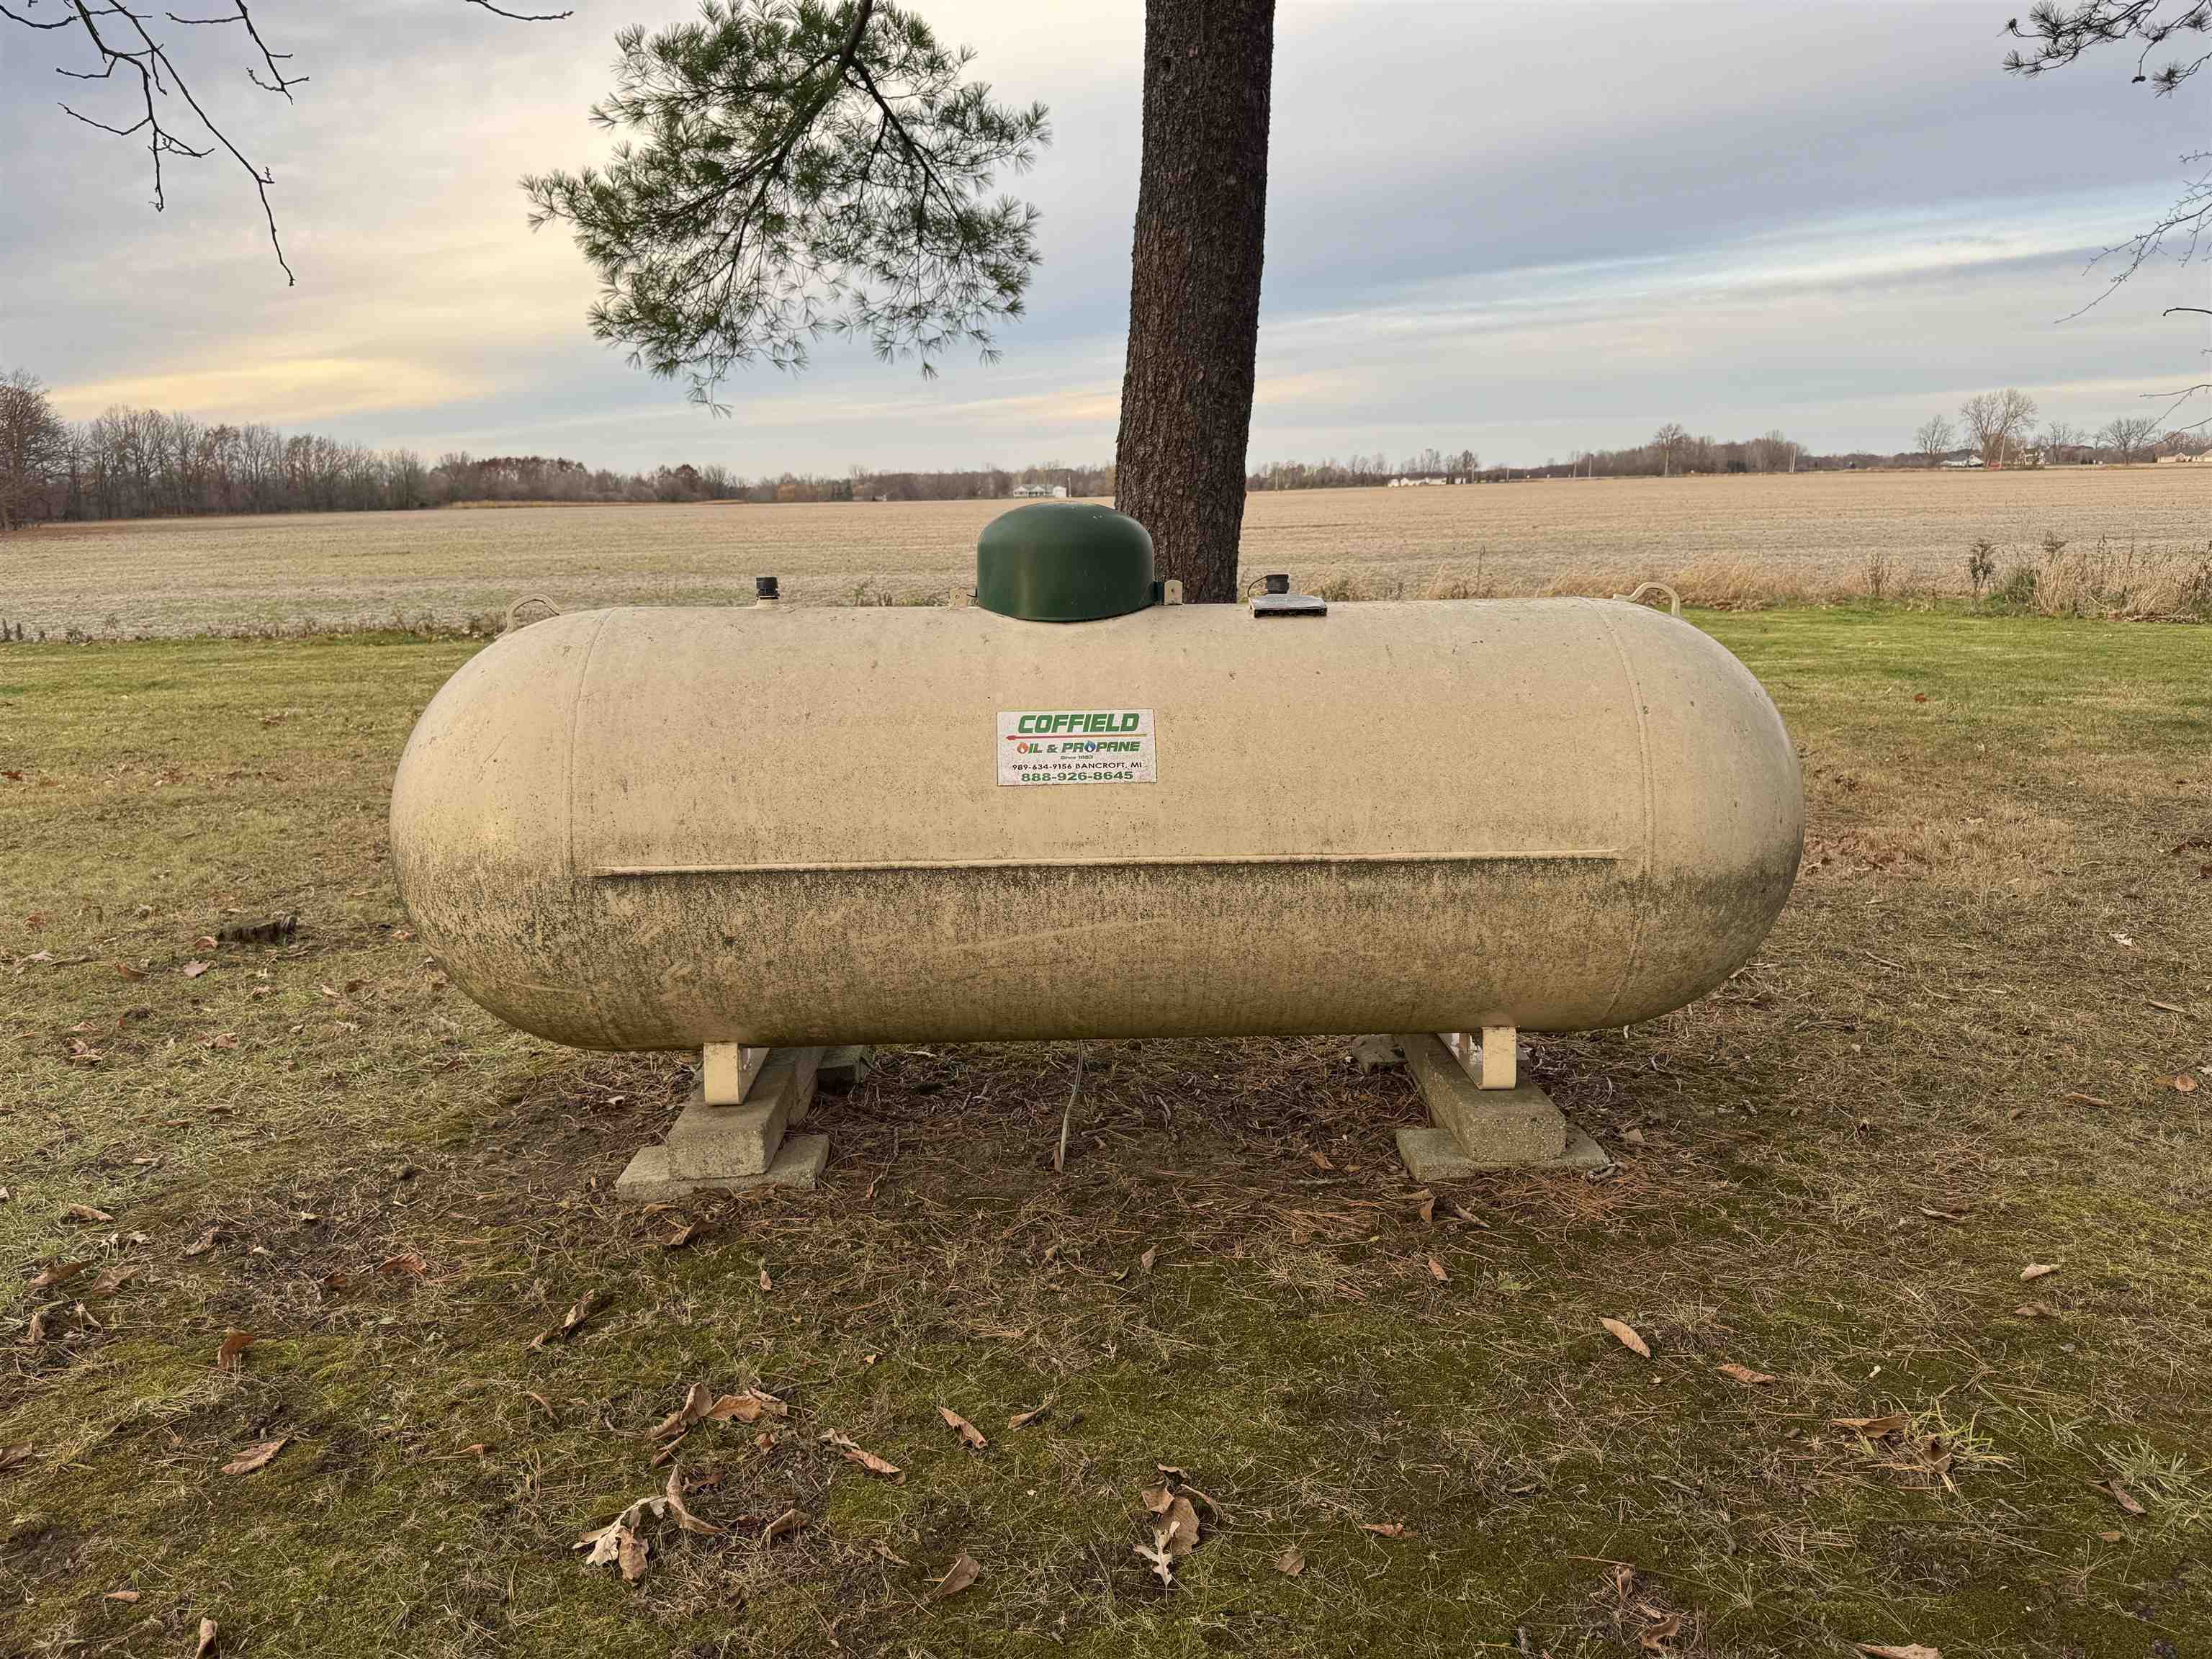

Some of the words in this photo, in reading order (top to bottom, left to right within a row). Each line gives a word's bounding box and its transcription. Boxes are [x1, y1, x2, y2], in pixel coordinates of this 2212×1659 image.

[1018, 714, 1140, 733] COFFIELD
[1017, 742, 1043, 754] OIL
[1047, 745, 1058, 754] &
[1062, 740, 1141, 752] PROPANE
[1021, 771, 1134, 781] 888-926-8645
